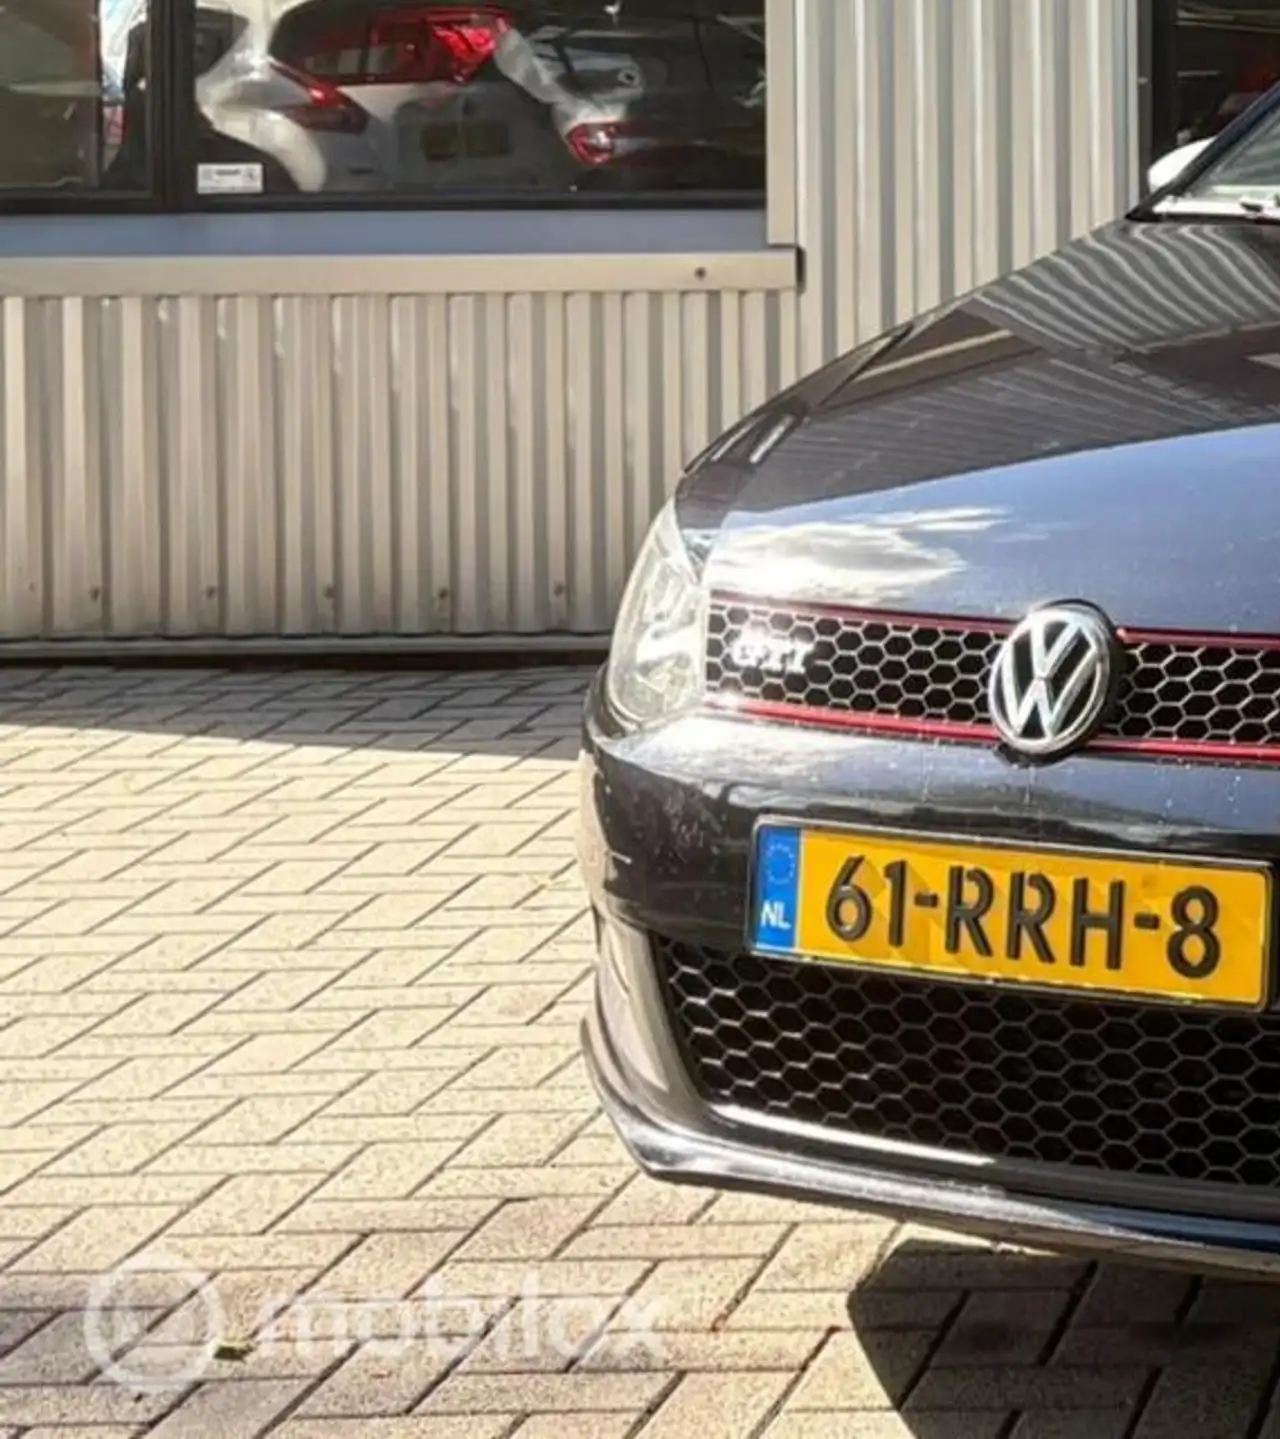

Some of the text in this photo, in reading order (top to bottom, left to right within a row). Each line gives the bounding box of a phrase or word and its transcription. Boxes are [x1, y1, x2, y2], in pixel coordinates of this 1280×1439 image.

[985, 606, 1111, 754] VW
[759, 898, 792, 931] NL
[825, 854, 1221, 979] 61-RRH-8
